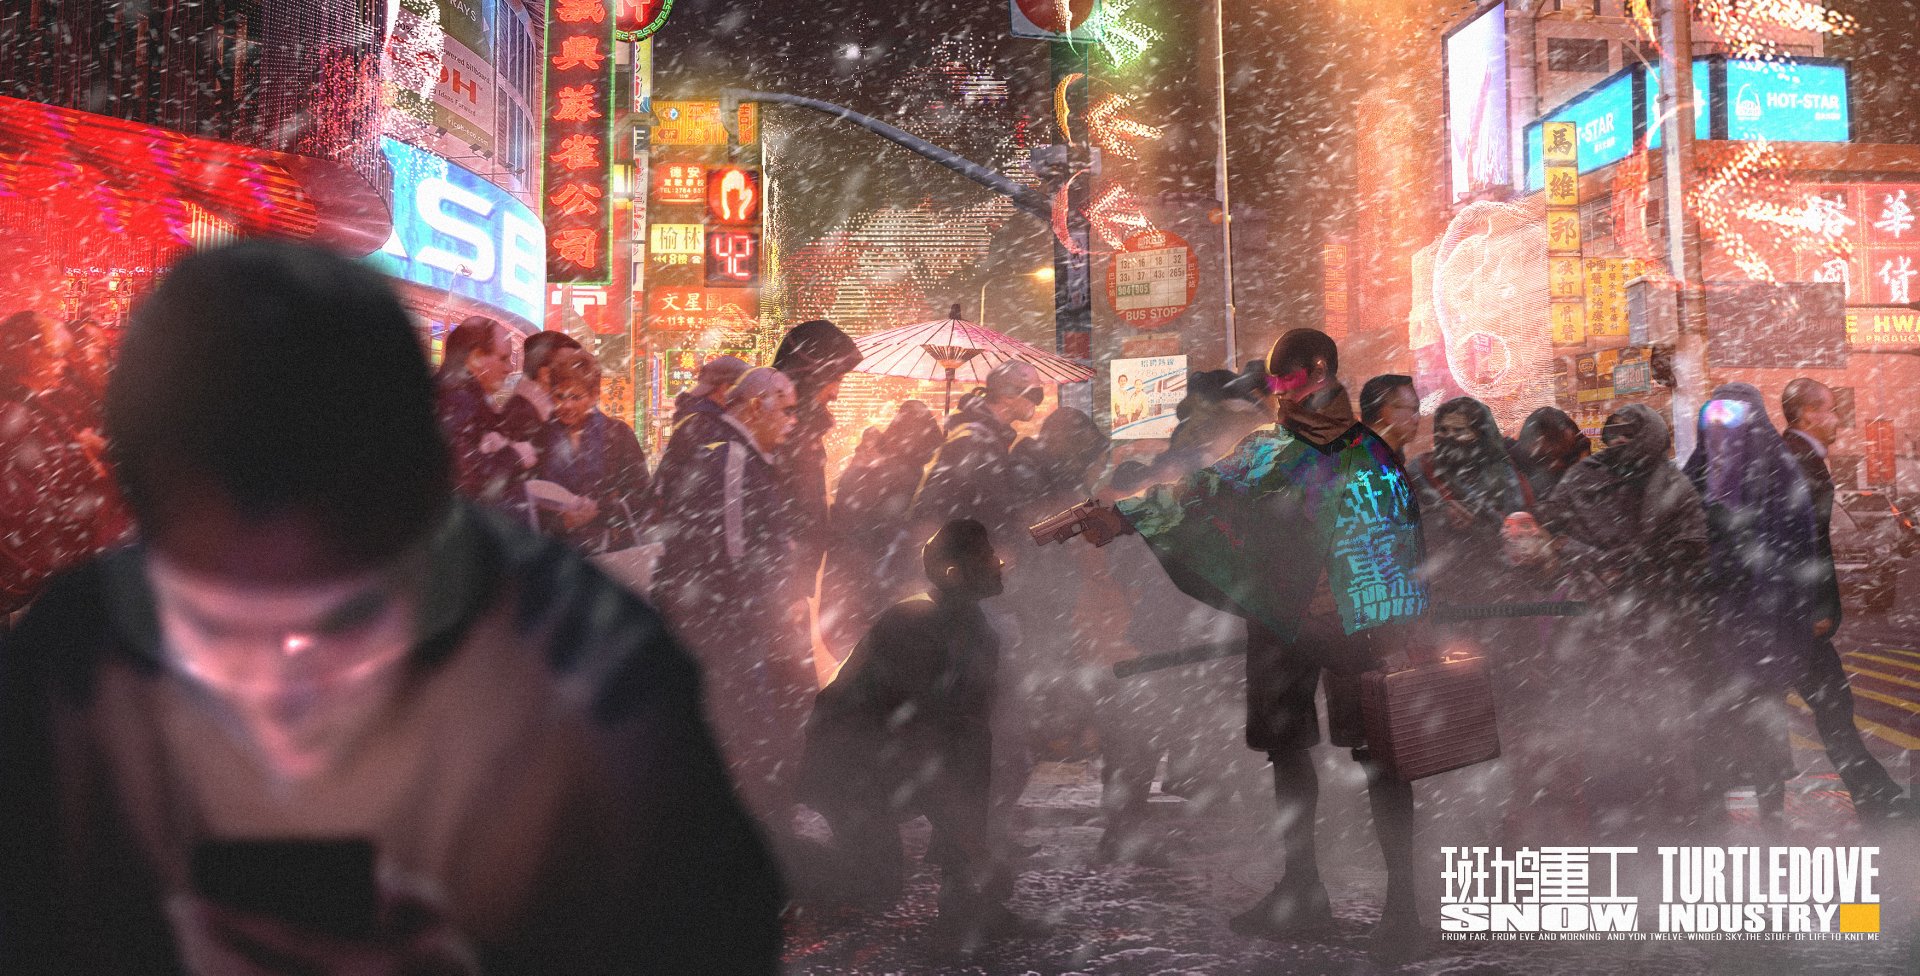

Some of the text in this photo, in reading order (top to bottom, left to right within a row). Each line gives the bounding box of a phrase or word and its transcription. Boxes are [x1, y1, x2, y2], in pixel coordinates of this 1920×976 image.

[1766, 91, 1839, 110] HOT-STAR
[1547, 128, 1578, 246] 馬維邦
[714, 234, 751, 277] 42
[1173, 255, 1182, 264] 32
[1126, 307, 1178, 321] BUS STOP
